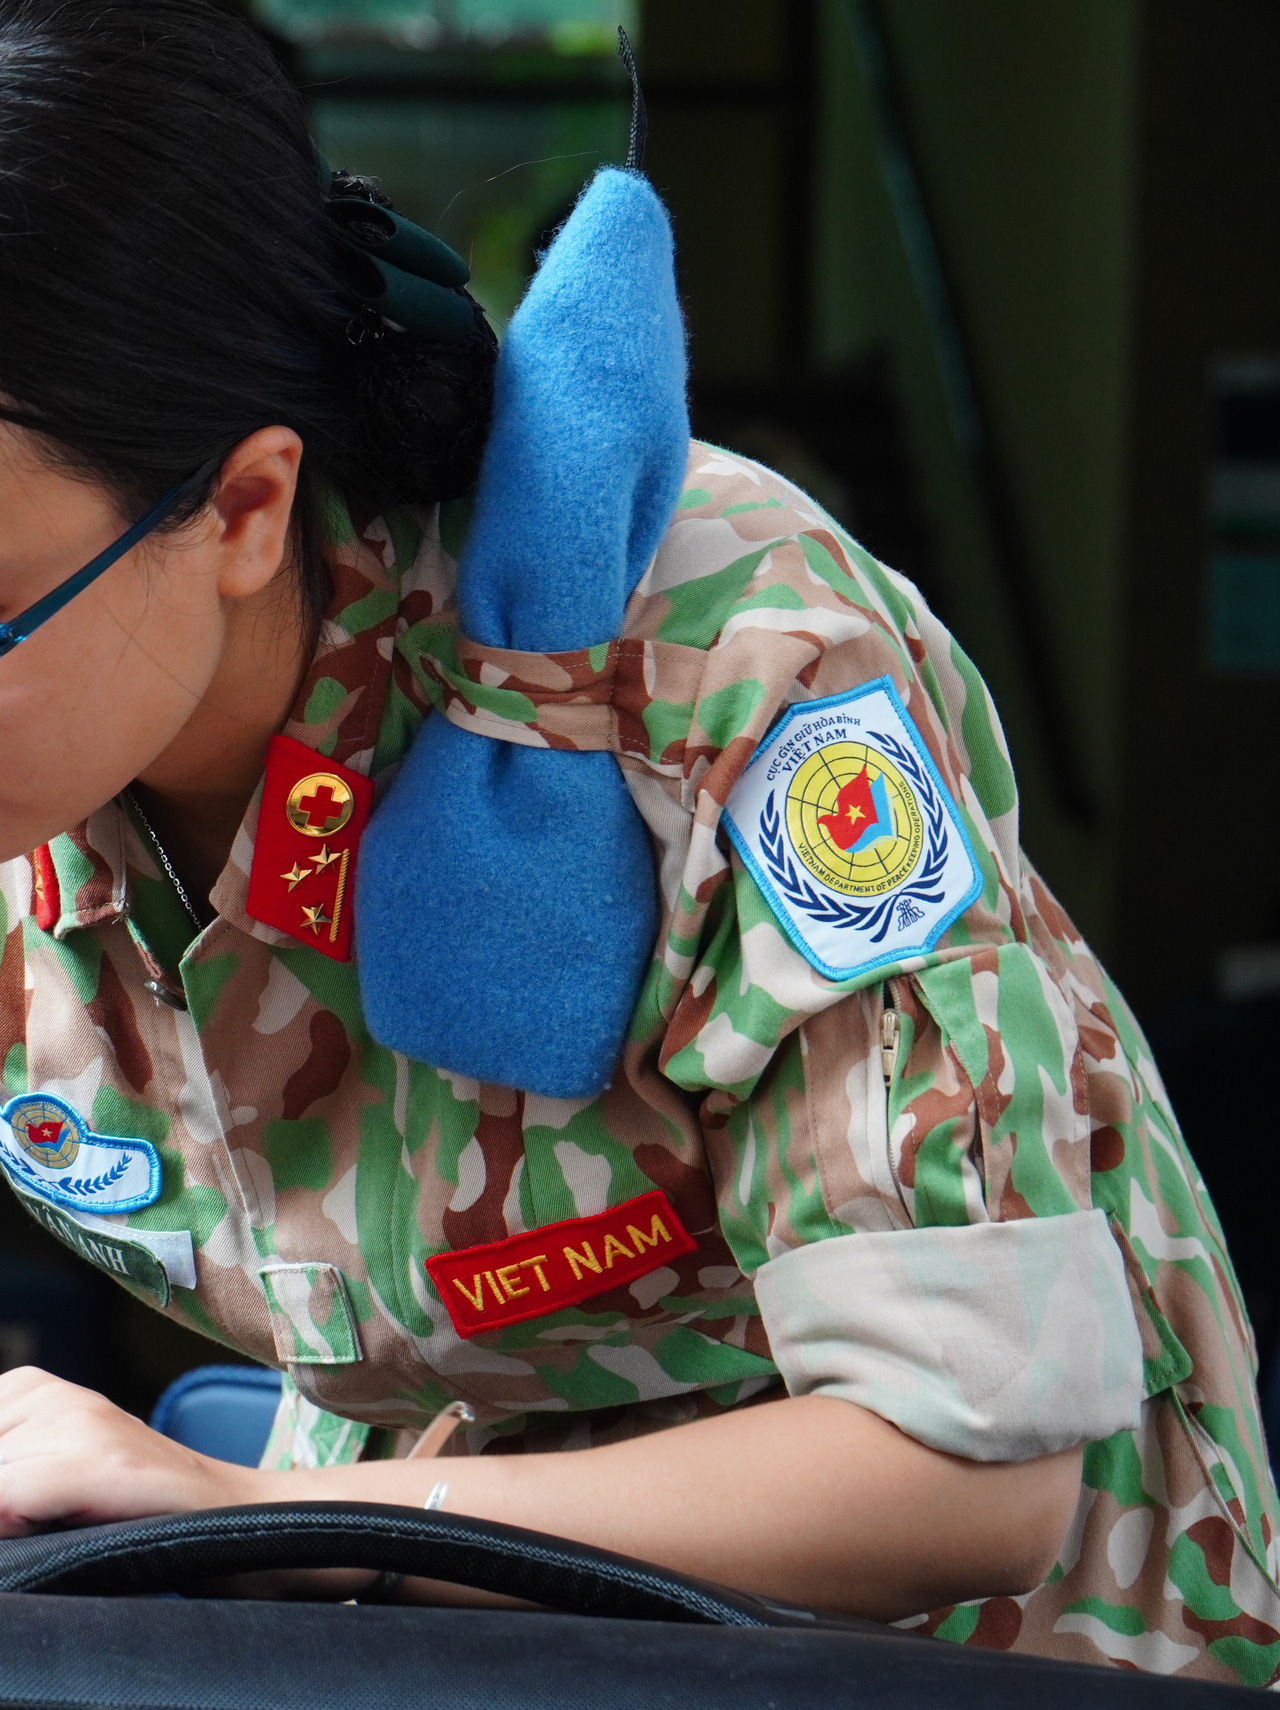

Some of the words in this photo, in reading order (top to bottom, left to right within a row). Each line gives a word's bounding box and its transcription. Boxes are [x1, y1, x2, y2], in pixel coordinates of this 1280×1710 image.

[766, 758, 782, 781] CỤC
[778, 739, 795, 759] GÌN
[812, 717, 836, 731] HÒA
[836, 713, 861, 726] BÌNH
[782, 740, 813, 772] VIỆT
[813, 728, 847, 747] NAM
[798, 842, 826, 876] VIETNAM
[825, 873, 875, 893] DEPARTMENT
[876, 883, 887, 892] OF
[898, 781, 921, 834] OPERATIONS
[78, 1234, 131, 1277] ANH
[452, 1254, 551, 1311] VIET
[563, 1214, 672, 1281] NAM
